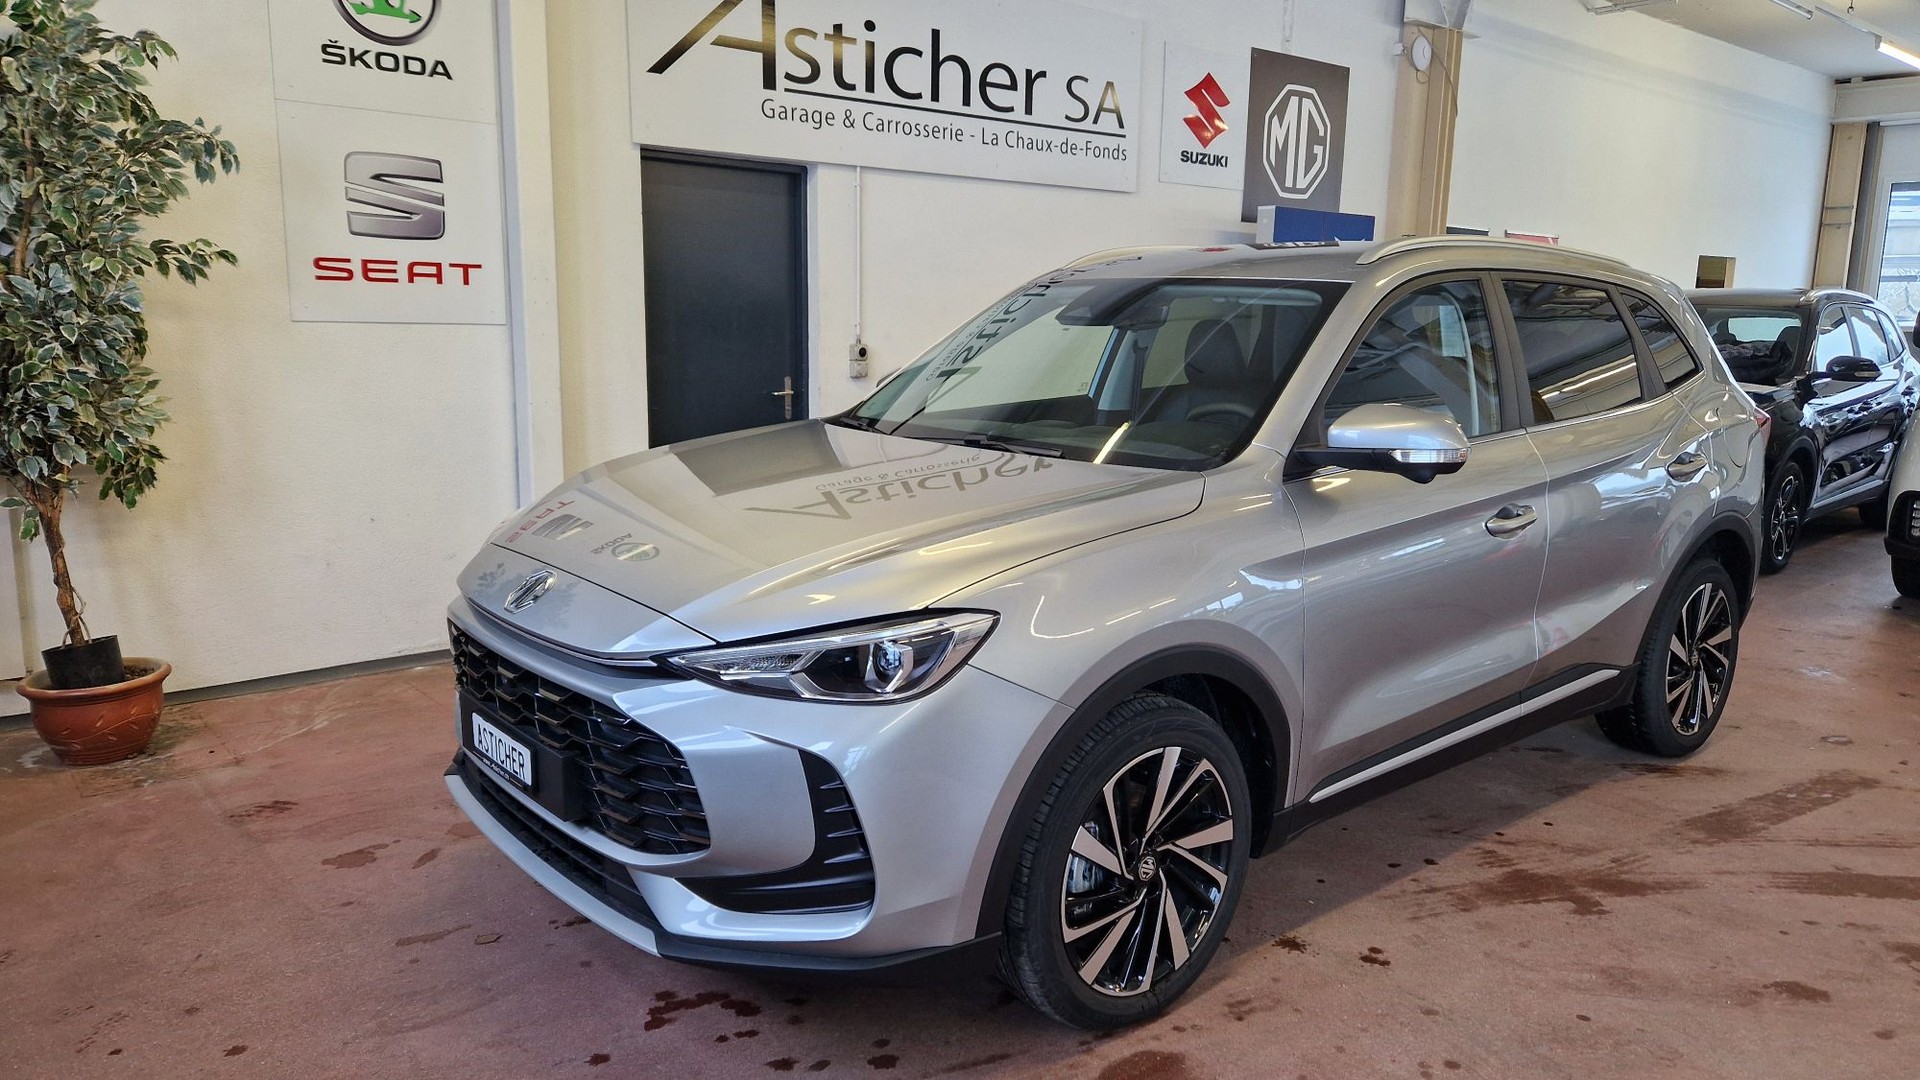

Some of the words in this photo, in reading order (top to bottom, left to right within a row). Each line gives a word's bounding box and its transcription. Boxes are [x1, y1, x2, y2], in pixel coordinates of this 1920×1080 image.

[320, 39, 453, 80] ŠKODA
[646, 0, 1047, 117] Asticher
[1064, 75, 1126, 129] SA
[761, 98, 835, 130] Garage
[842, 108, 856, 129] &
[862, 111, 965, 142] Carrosserie
[981, 127, 999, 146] La
[1004, 130, 1128, 162] Chaux-de-Fonds
[1180, 150, 1229, 168] SUZUKI
[1269, 95, 1325, 189] MG
[312, 257, 483, 286] SEAT
[477, 723, 526, 781] ASTICHER
